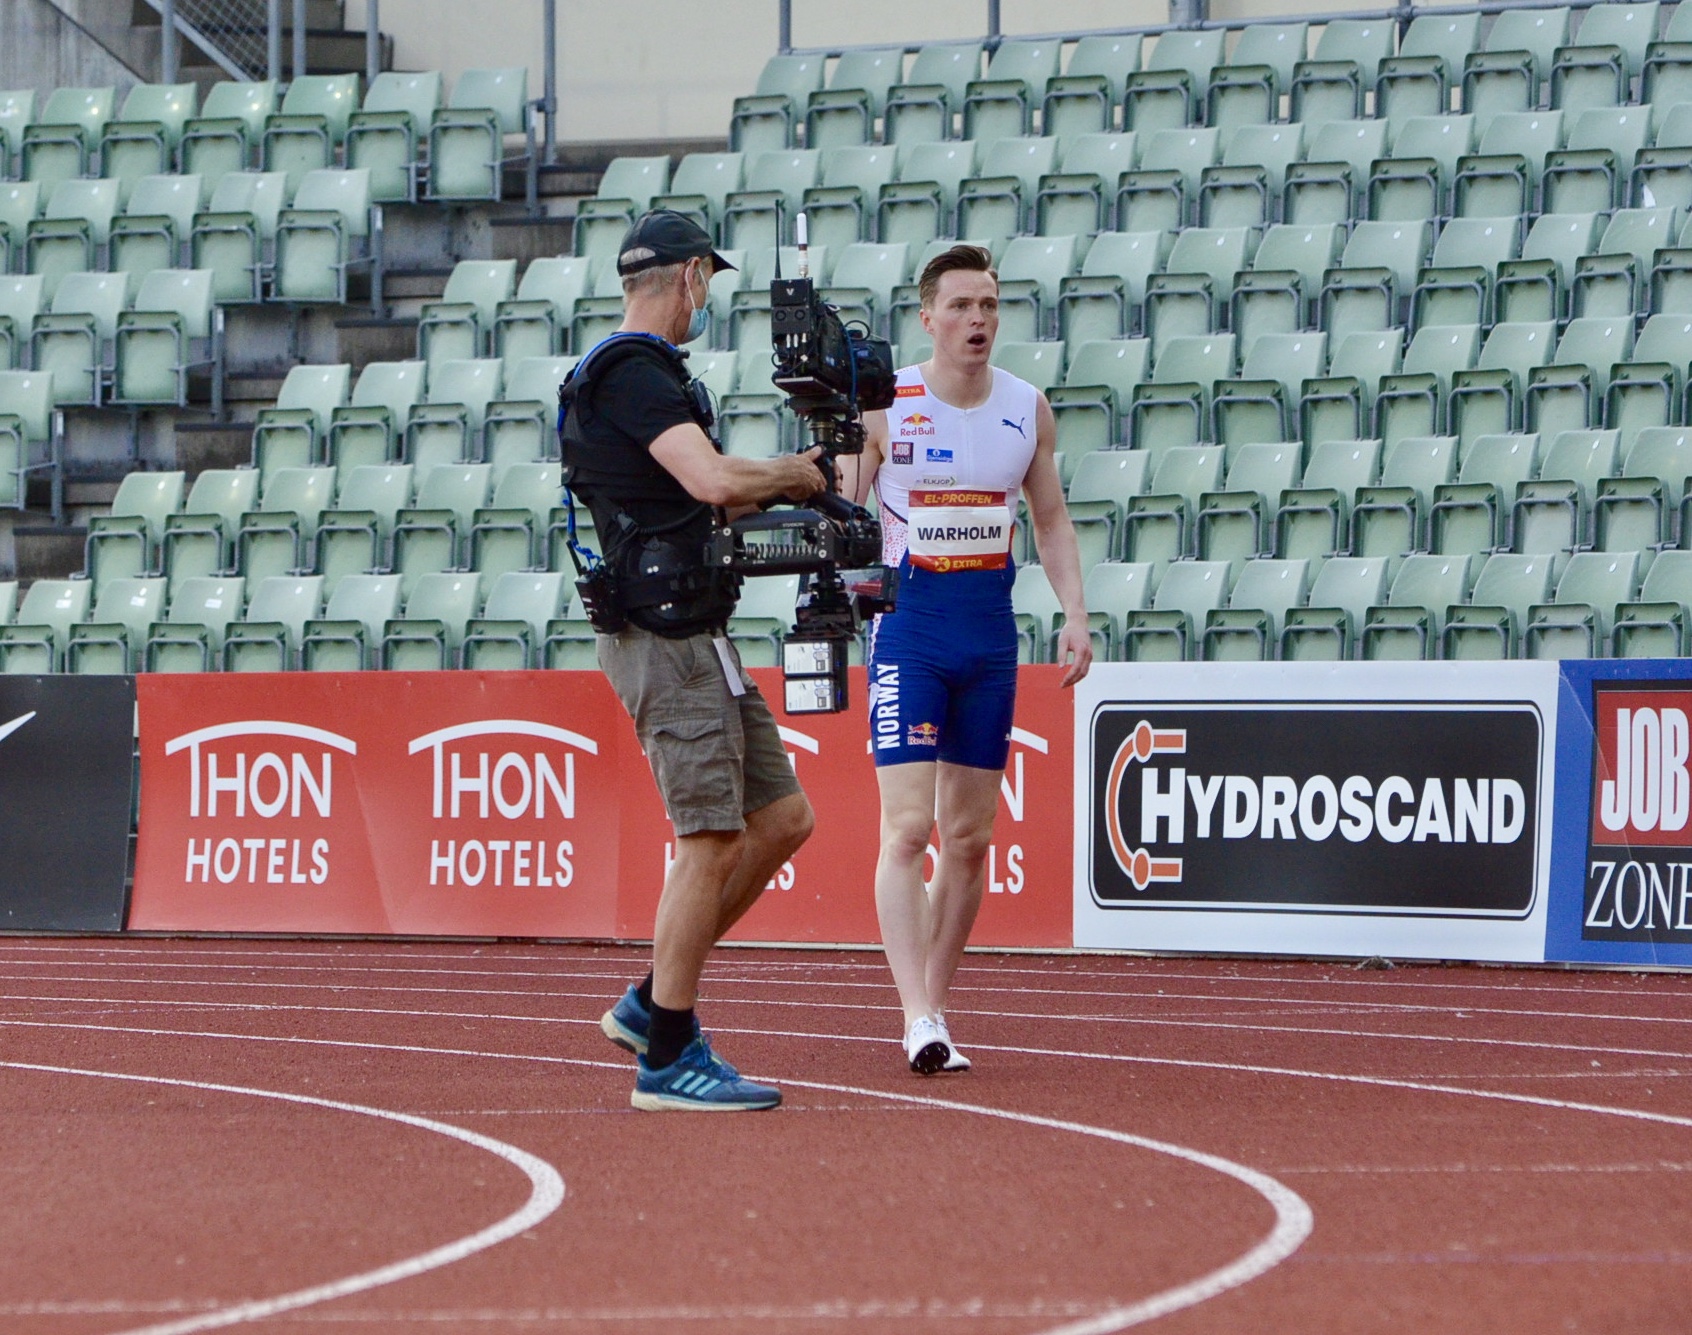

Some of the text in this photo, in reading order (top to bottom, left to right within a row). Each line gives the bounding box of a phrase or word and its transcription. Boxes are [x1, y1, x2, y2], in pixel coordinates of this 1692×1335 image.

[893, 443, 910, 456] JOB
[900, 426, 935, 437] Red Bull
[892, 456, 911, 464] ZONE
[924, 493, 993, 504] EL-PROFFEN
[917, 526, 1002, 541] WARHOLM
[953, 559, 983, 568] EXTRA
[877, 663, 900, 750] NORWAY
[165, 720, 357, 818] THON
[408, 719, 598, 820] THON
[1600, 706, 1690, 833] JOB
[1140, 767, 1526, 845] HYDROSCAND
[185, 837, 329, 886] HOTELS
[429, 839, 574, 888] HOTELS
[1584, 860, 1692, 931] ZONE
